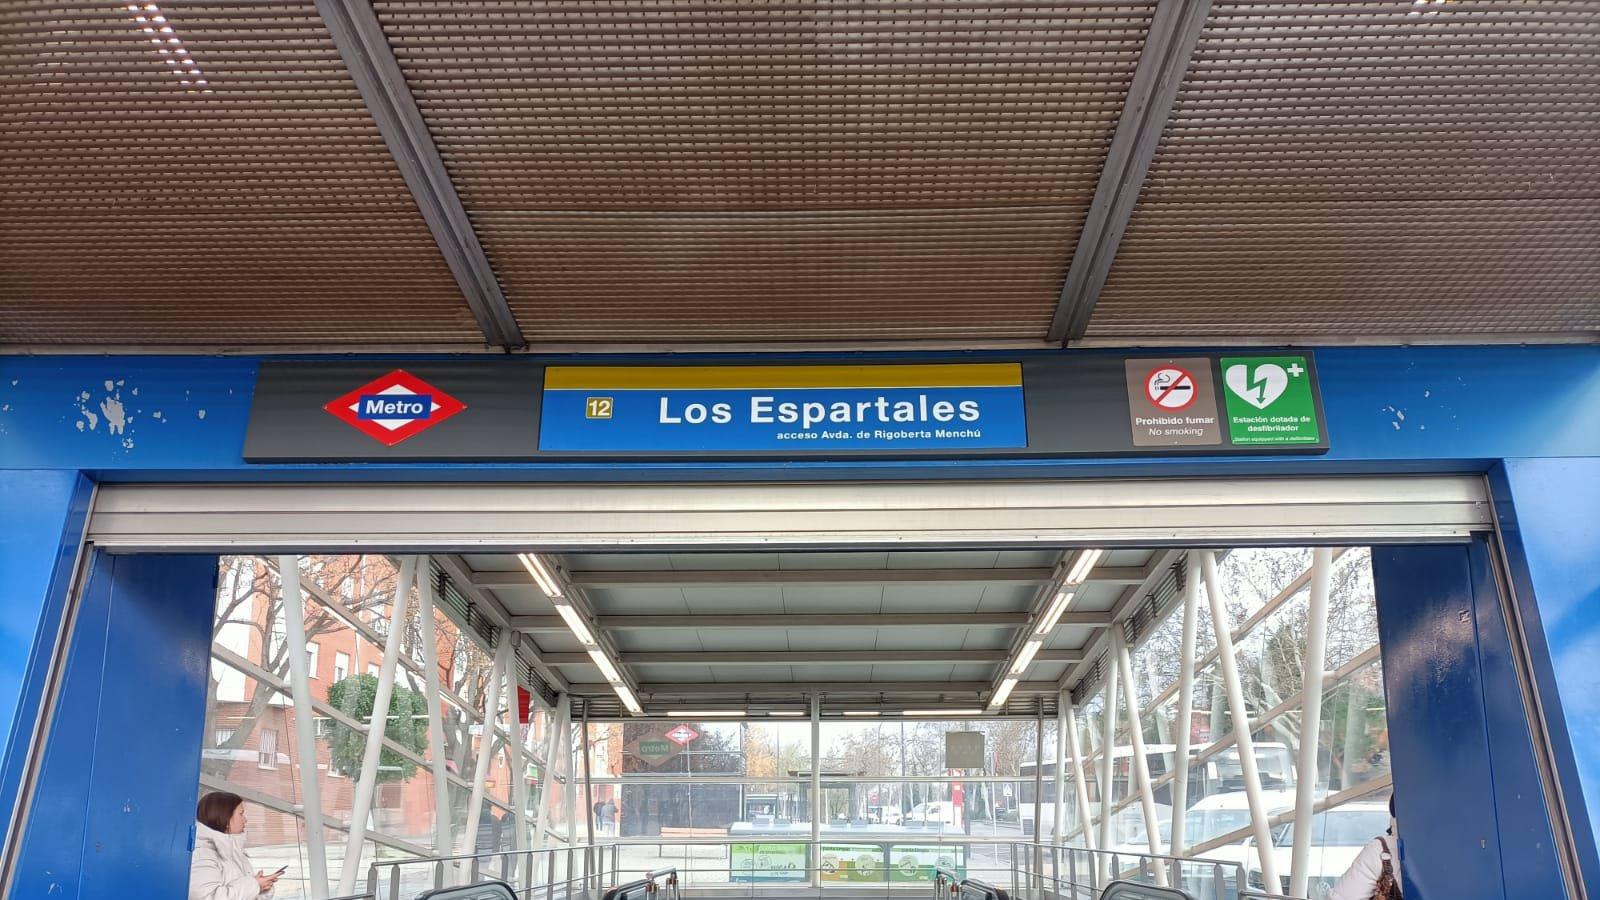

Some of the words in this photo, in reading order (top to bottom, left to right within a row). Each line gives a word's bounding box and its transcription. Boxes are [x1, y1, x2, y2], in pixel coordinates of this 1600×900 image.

[366, 399, 424, 415] Metro
[588, 400, 610, 416] 12
[659, 397, 732, 424] Los
[750, 395, 980, 428] Espartales
[1135, 416, 1184, 426] Prohibido
[1185, 416, 1215, 425] fumar
[1232, 415, 1268, 424] Estación
[1270, 415, 1298, 423] dotada
[1300, 415, 1311, 423] de
[1148, 427, 1162, 436] No
[1164, 426, 1204, 438] smoking
[1247, 424, 1300, 432] desfibrilador
[777, 431, 818, 440] acceso
[821, 429, 852, 440] Avda.
[856, 429, 870, 439] de
[874, 429, 932, 441] Rigoberta
[935, 428, 981, 438] Menchú
